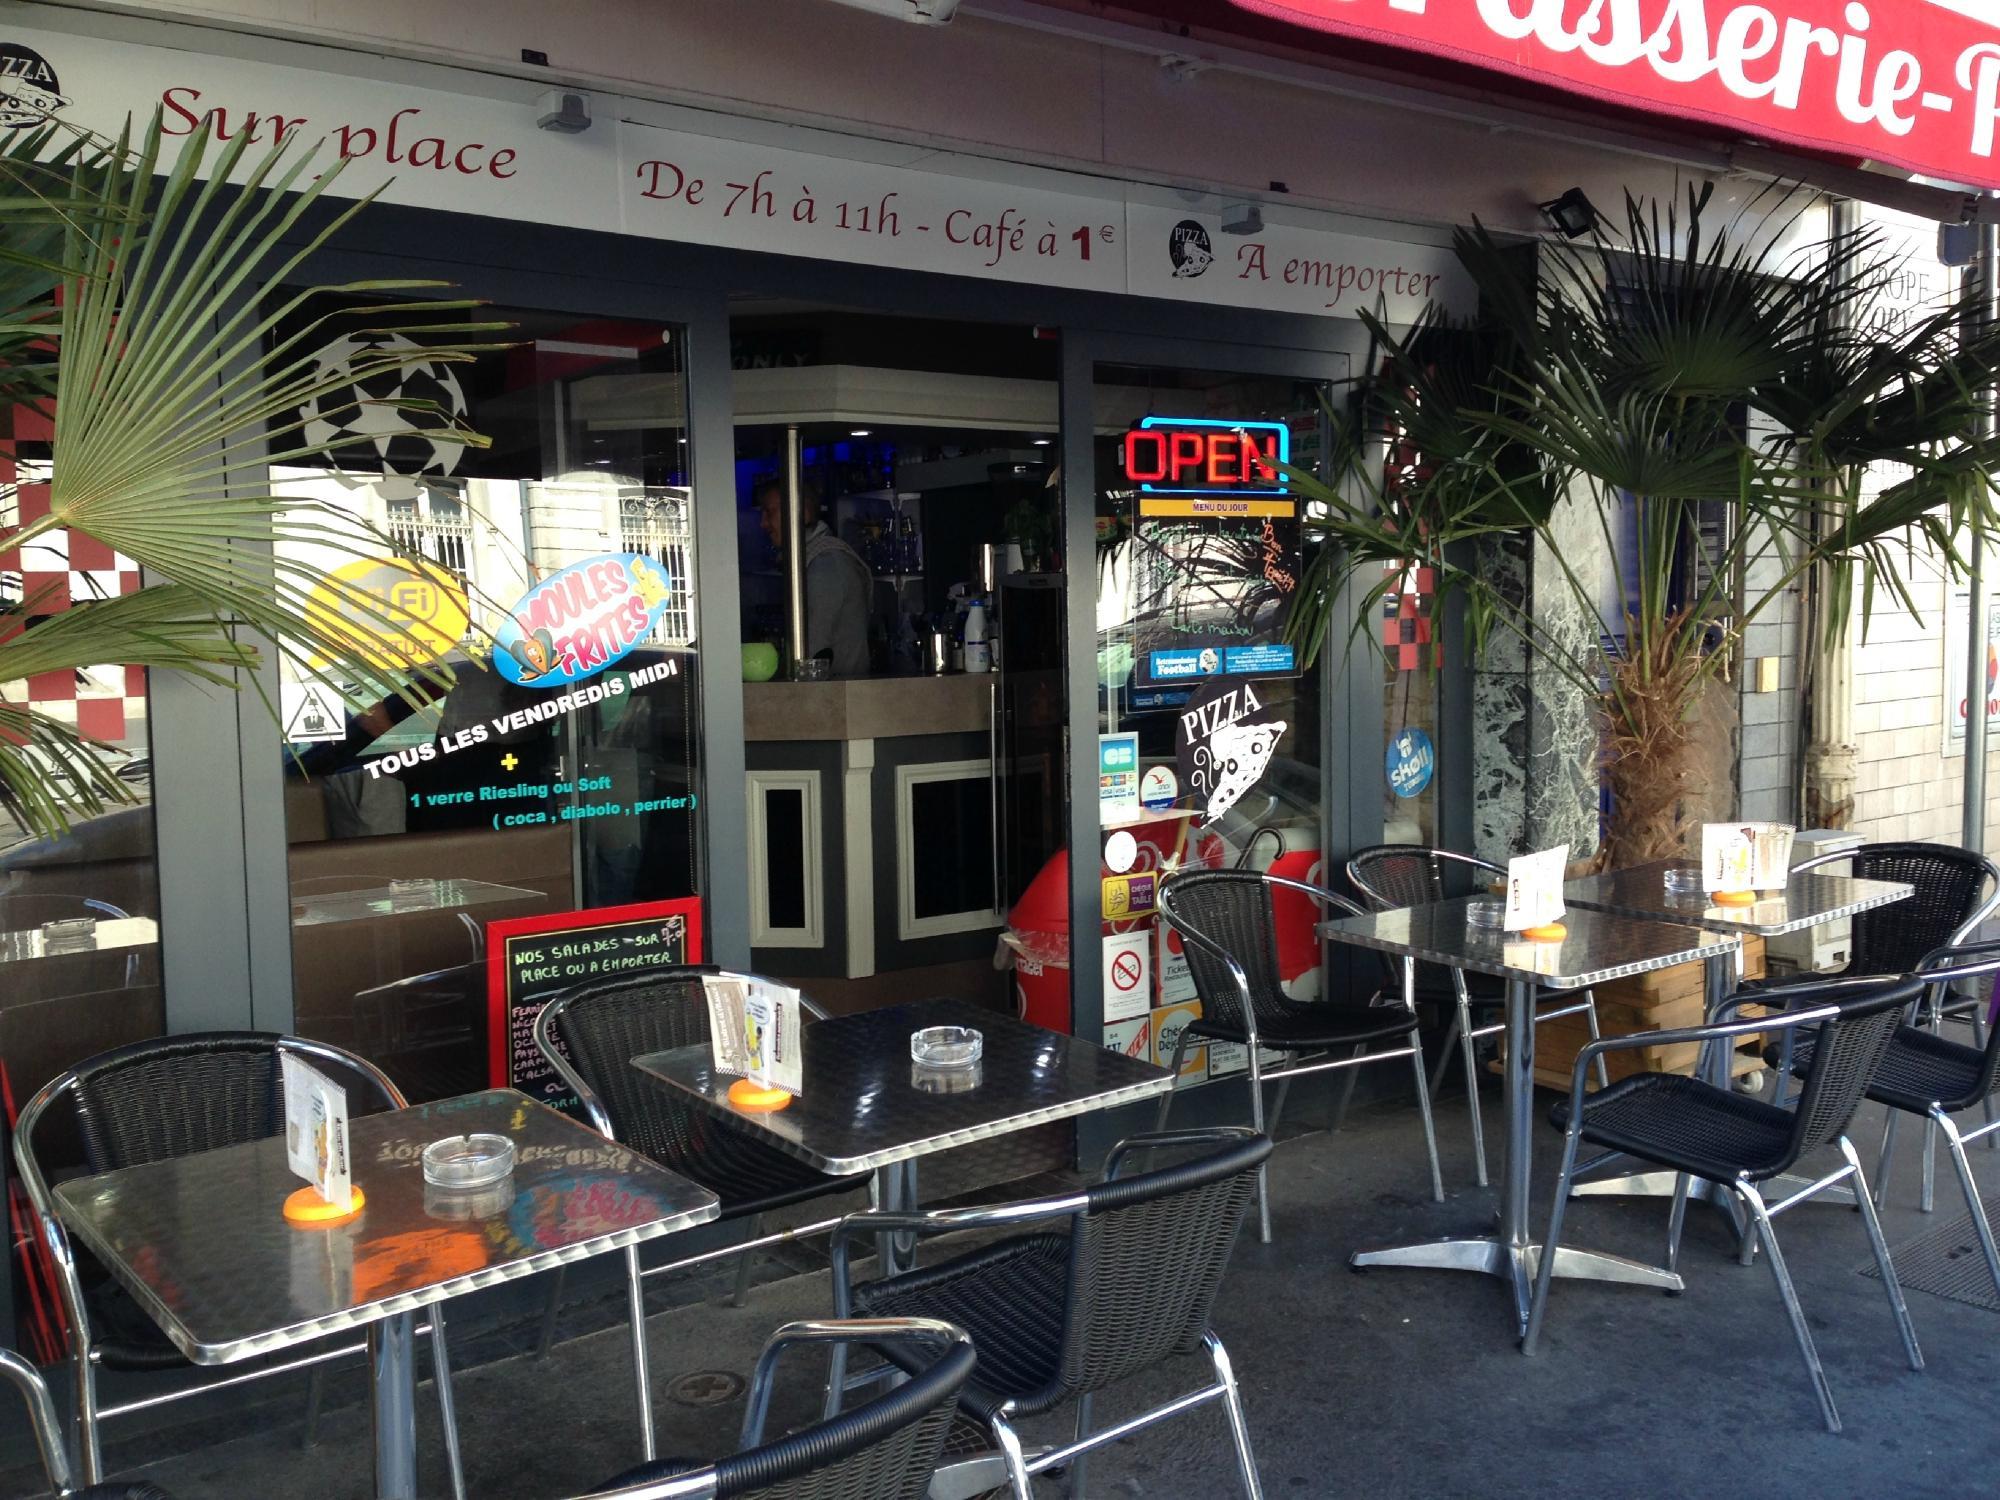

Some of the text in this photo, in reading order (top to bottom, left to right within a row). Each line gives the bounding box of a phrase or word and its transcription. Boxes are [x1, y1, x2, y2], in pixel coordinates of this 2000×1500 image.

[0, 55, 53, 82] ZZA
[160, 87, 517, 181] Sur place
[636, 160, 704, 205] De
[723, 171, 777, 217] 7h
[792, 185, 818, 224] à
[834, 192, 901, 236] 11h
[944, 208, 1027, 267] Café
[1037, 220, 1059, 257] à
[1174, 227, 1209, 246] PIZZA
[1236, 243, 1441, 308] A emporter
[1125, 430, 1277, 483] OPEN
[1192, 502, 1248, 512] MENU DU JOUR
[517, 561, 629, 641] MOULES
[554, 595, 649, 675] FRITES
[1157, 662, 1198, 675] Football
[362, 658, 678, 780] TOUS LES VENDREDIS MIDI
[1180, 683, 1263, 746] PIZZA
[1103, 747, 1133, 765] CB
[410, 775, 612, 807] 1 verre Riesling ou Soft
[504, 811, 546, 827] coca
[560, 803, 621, 821] diabolo
[633, 796, 687, 816] perrier
[1131, 895, 1153, 905] TABLE
[515, 950, 545, 966] NOS
[551, 938, 620, 959] SALADES
[634, 933, 660, 947] SUR
[521, 951, 673, 984] PLACE OU A EMPORTER
